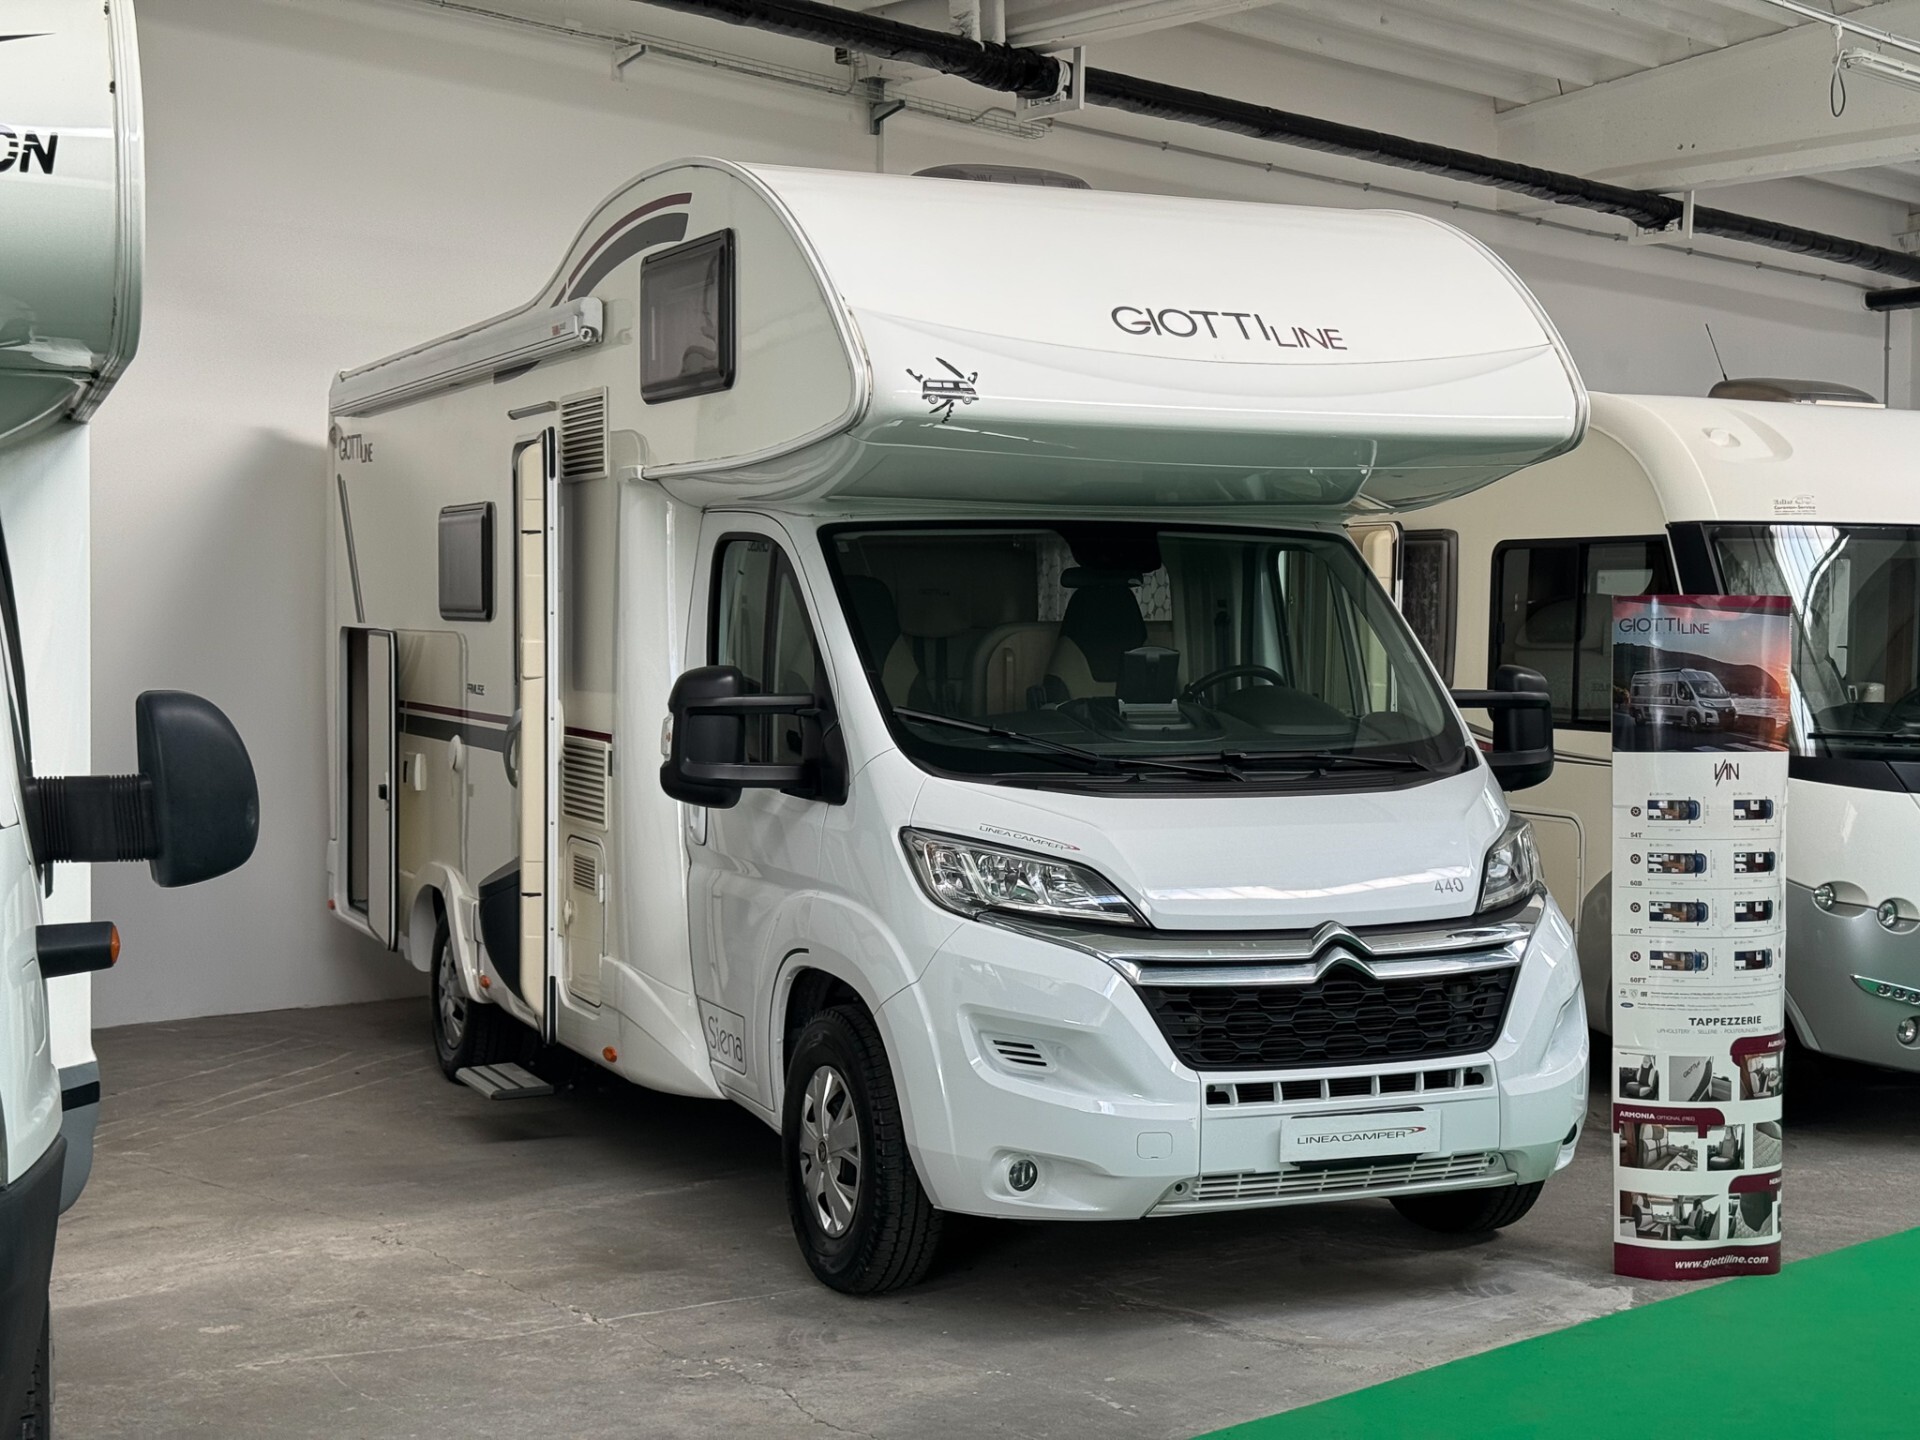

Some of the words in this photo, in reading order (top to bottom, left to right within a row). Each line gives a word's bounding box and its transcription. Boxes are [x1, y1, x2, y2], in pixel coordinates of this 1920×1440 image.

[1434, 877, 1464, 894] 440
[1688, 1015, 1762, 1027] TAPPEZZERIE
[708, 1015, 743, 1063] Siena
[1619, 1110, 1656, 1120] ARMONIA
[1675, 1255, 1769, 1270] www.giottiline.com
